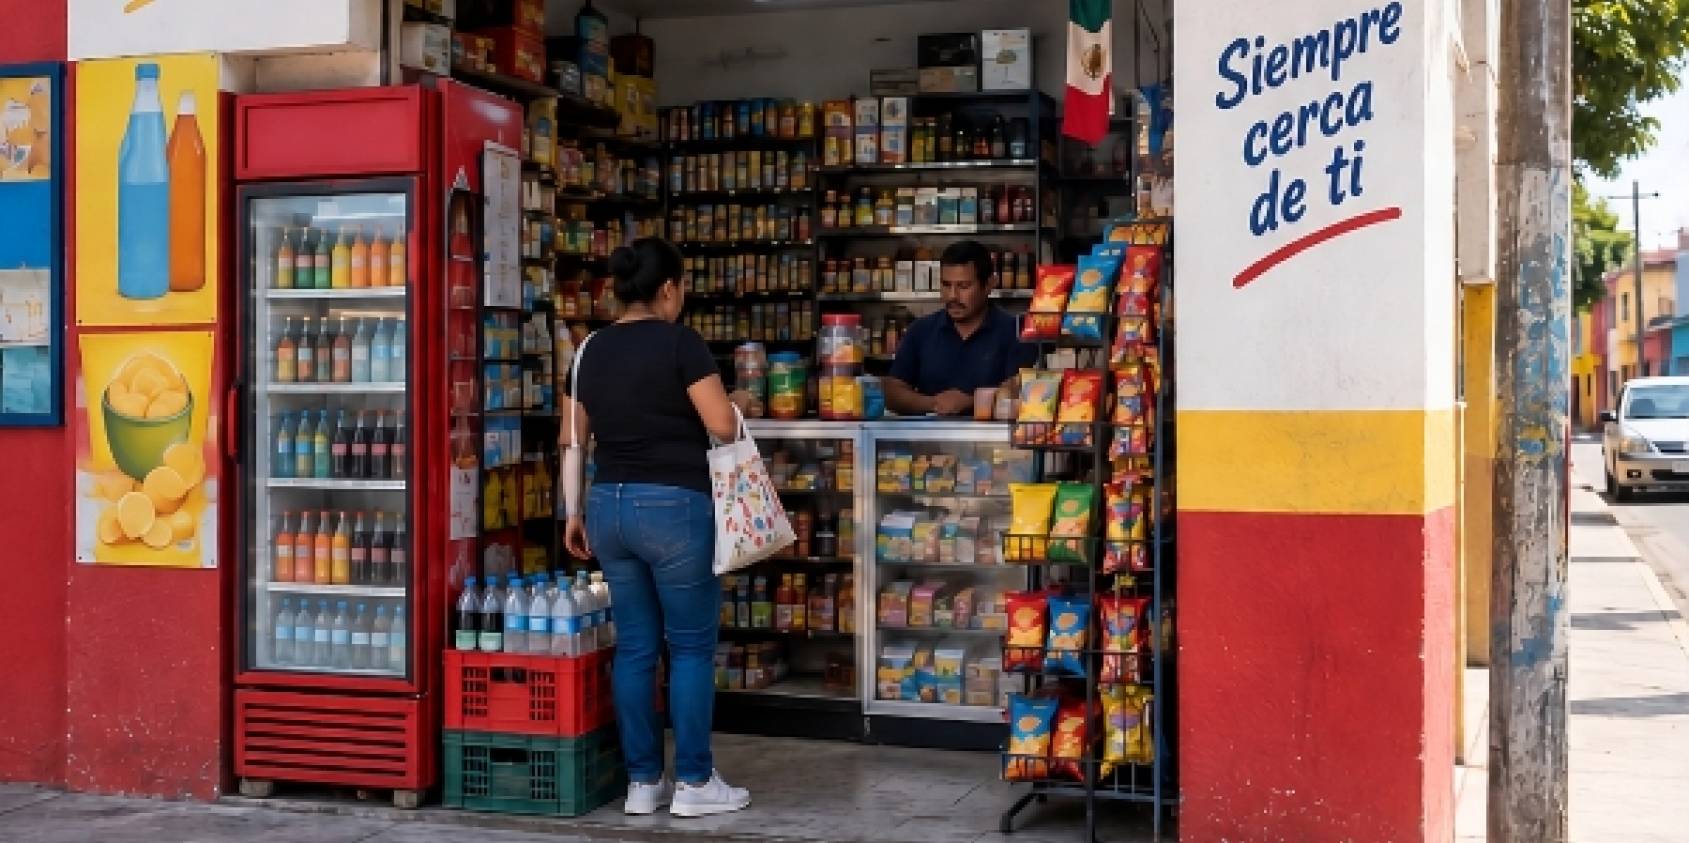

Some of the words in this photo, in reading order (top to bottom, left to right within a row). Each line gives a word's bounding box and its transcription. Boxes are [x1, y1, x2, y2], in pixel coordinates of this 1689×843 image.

[1215, 1, 1402, 110] Siempre
[1243, 80, 1373, 167] cerca
[1249, 167, 1307, 237] de
[1325, 139, 1366, 206] ti
